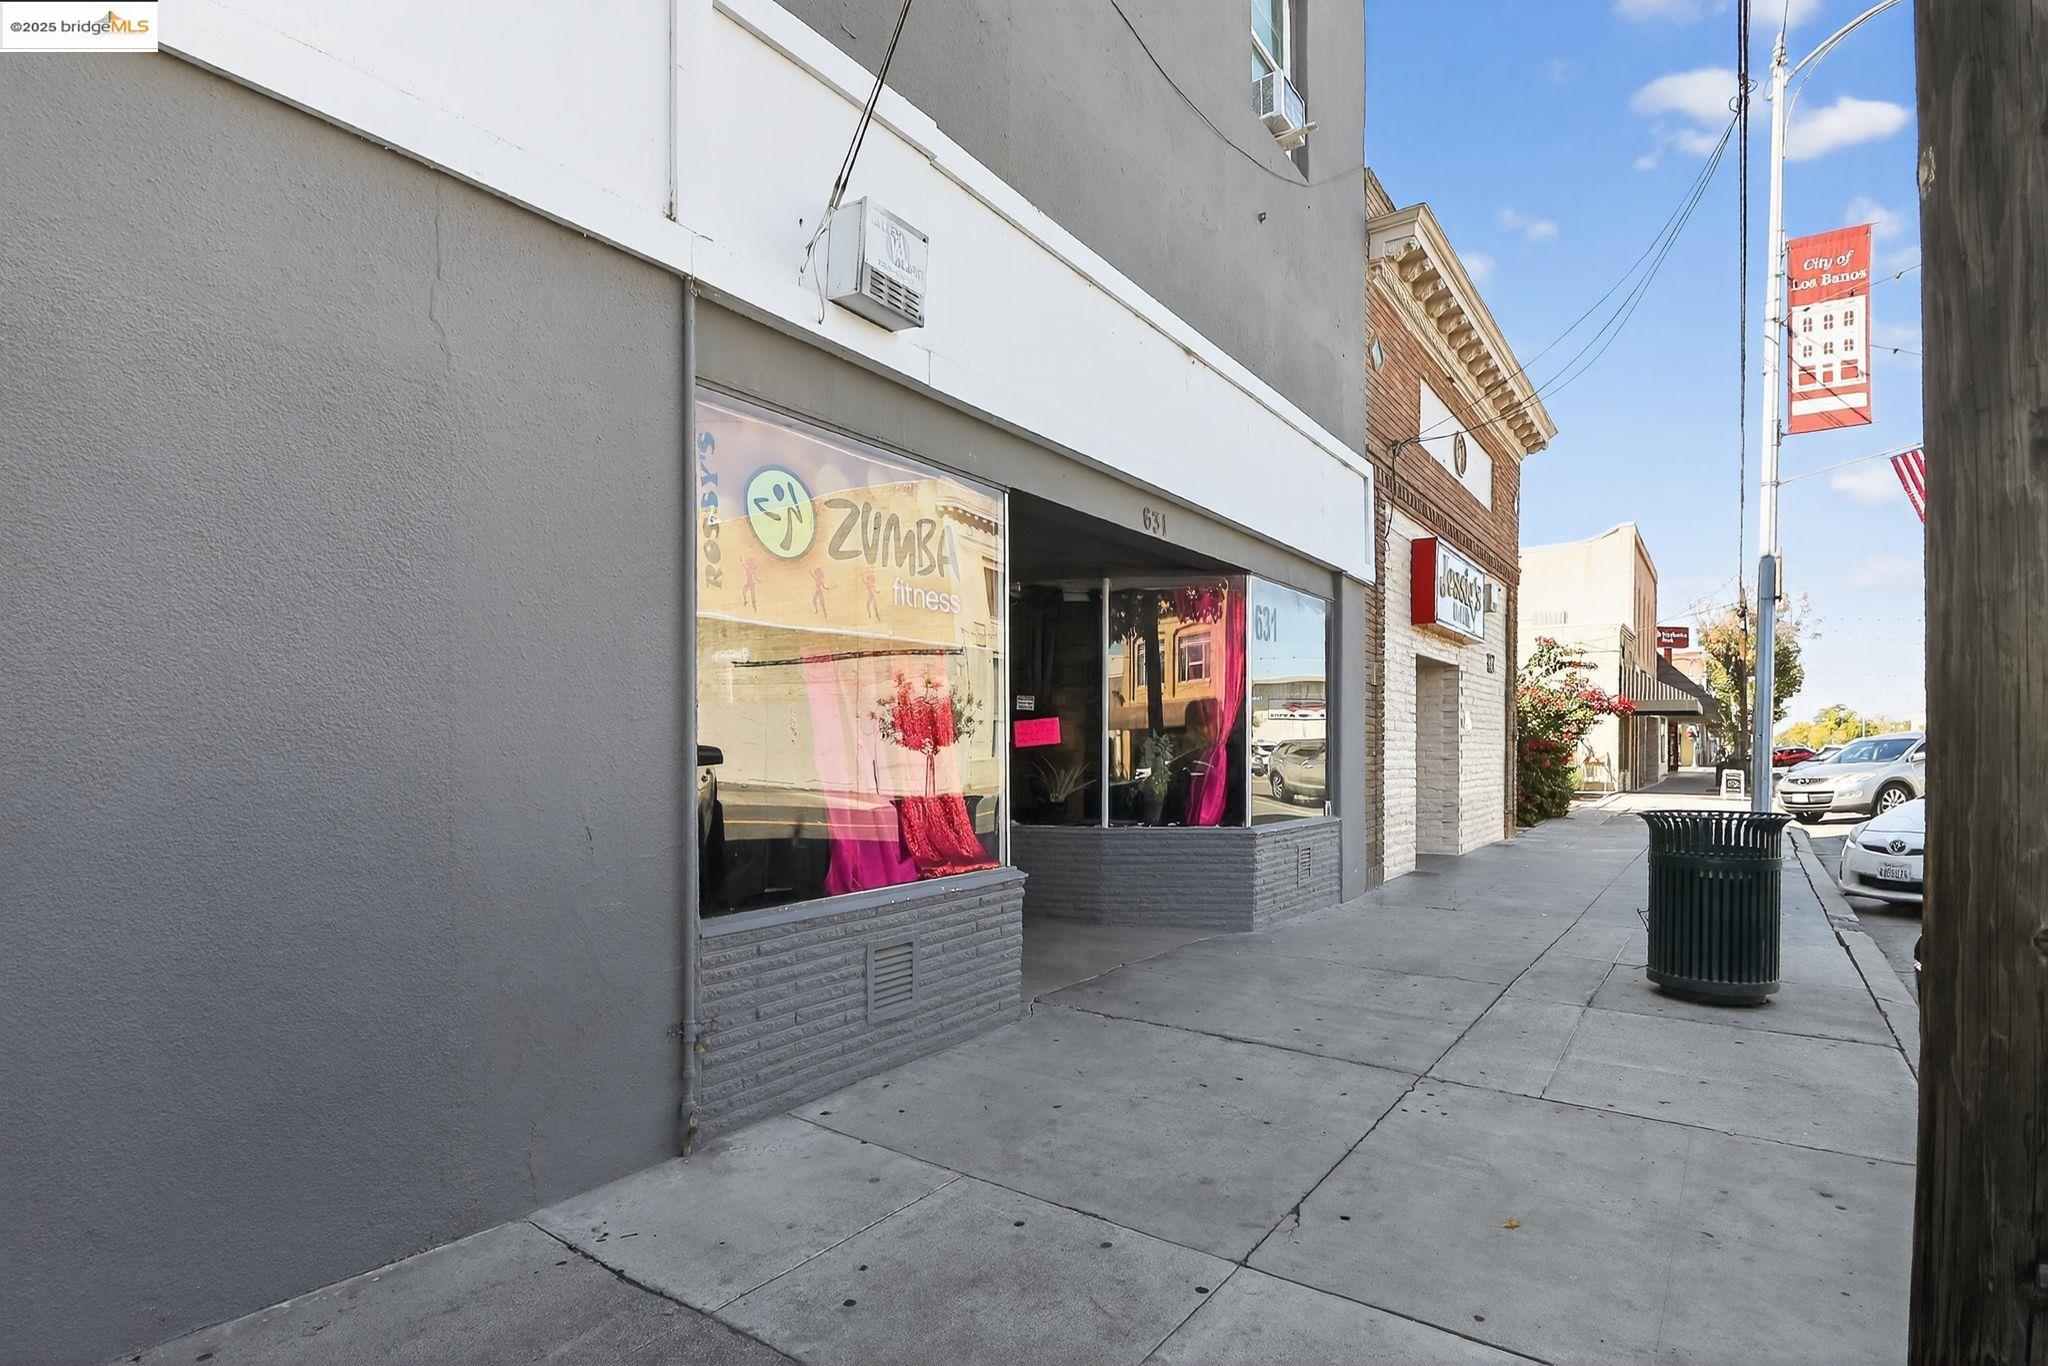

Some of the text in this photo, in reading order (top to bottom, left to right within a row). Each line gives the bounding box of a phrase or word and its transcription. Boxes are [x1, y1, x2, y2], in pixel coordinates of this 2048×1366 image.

[1803, 250, 1855, 270] City of
[1791, 268, 1867, 291] Los Banos
[1142, 506, 1167, 536] 631
[823, 498, 961, 582] ZUMBA
[892, 577, 962, 615] fitness
[1254, 604, 1278, 643] 631
